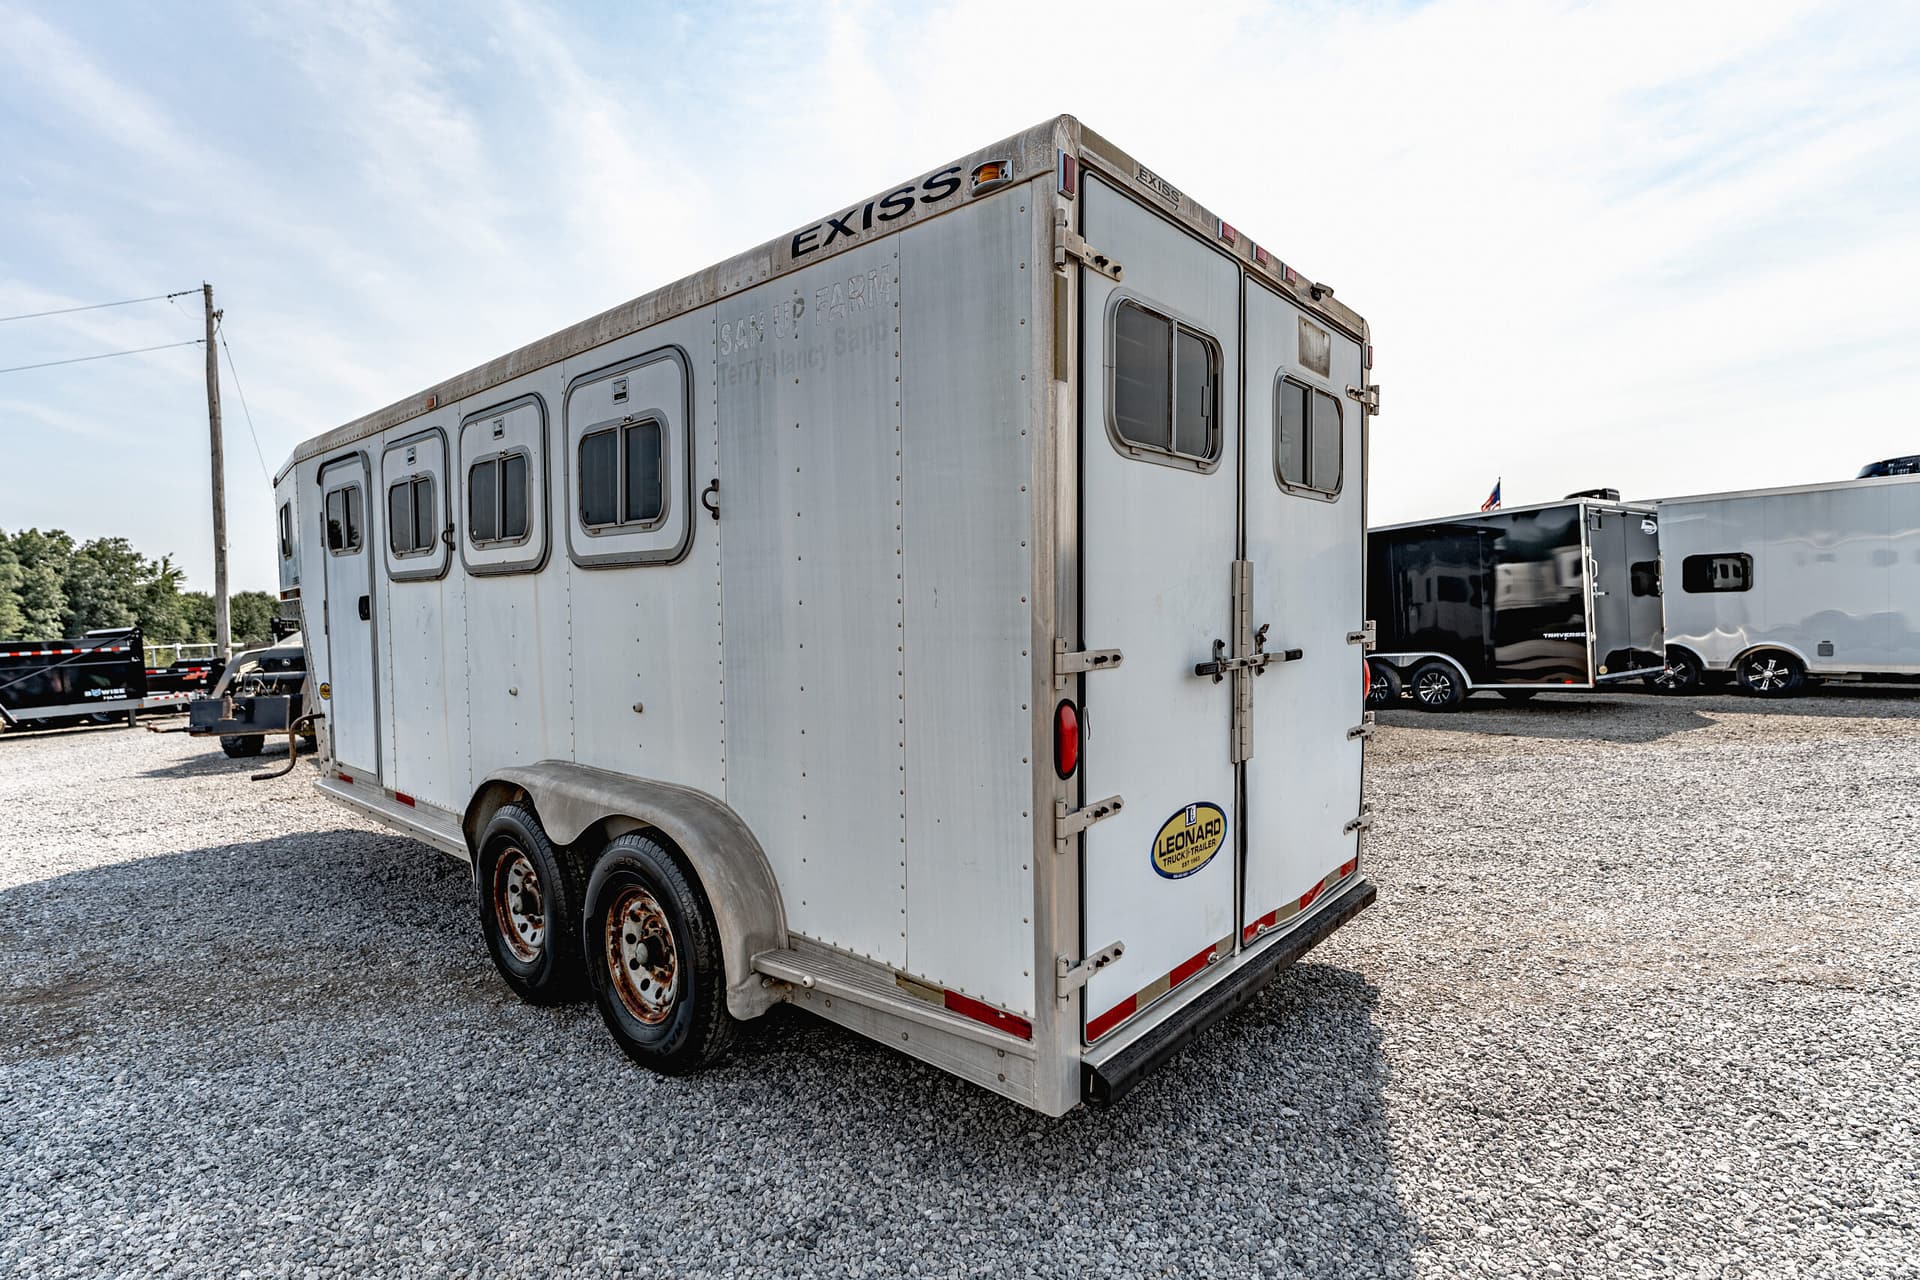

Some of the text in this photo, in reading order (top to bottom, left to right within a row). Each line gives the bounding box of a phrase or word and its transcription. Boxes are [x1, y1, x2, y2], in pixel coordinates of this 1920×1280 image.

[1138, 167, 1181, 204] EXISS
[791, 166, 962, 260] EXISS
[1158, 817, 1221, 858] LEONARD
[1162, 851, 1186, 867] TRUCK
[1190, 838, 1216, 856] TRAILER
